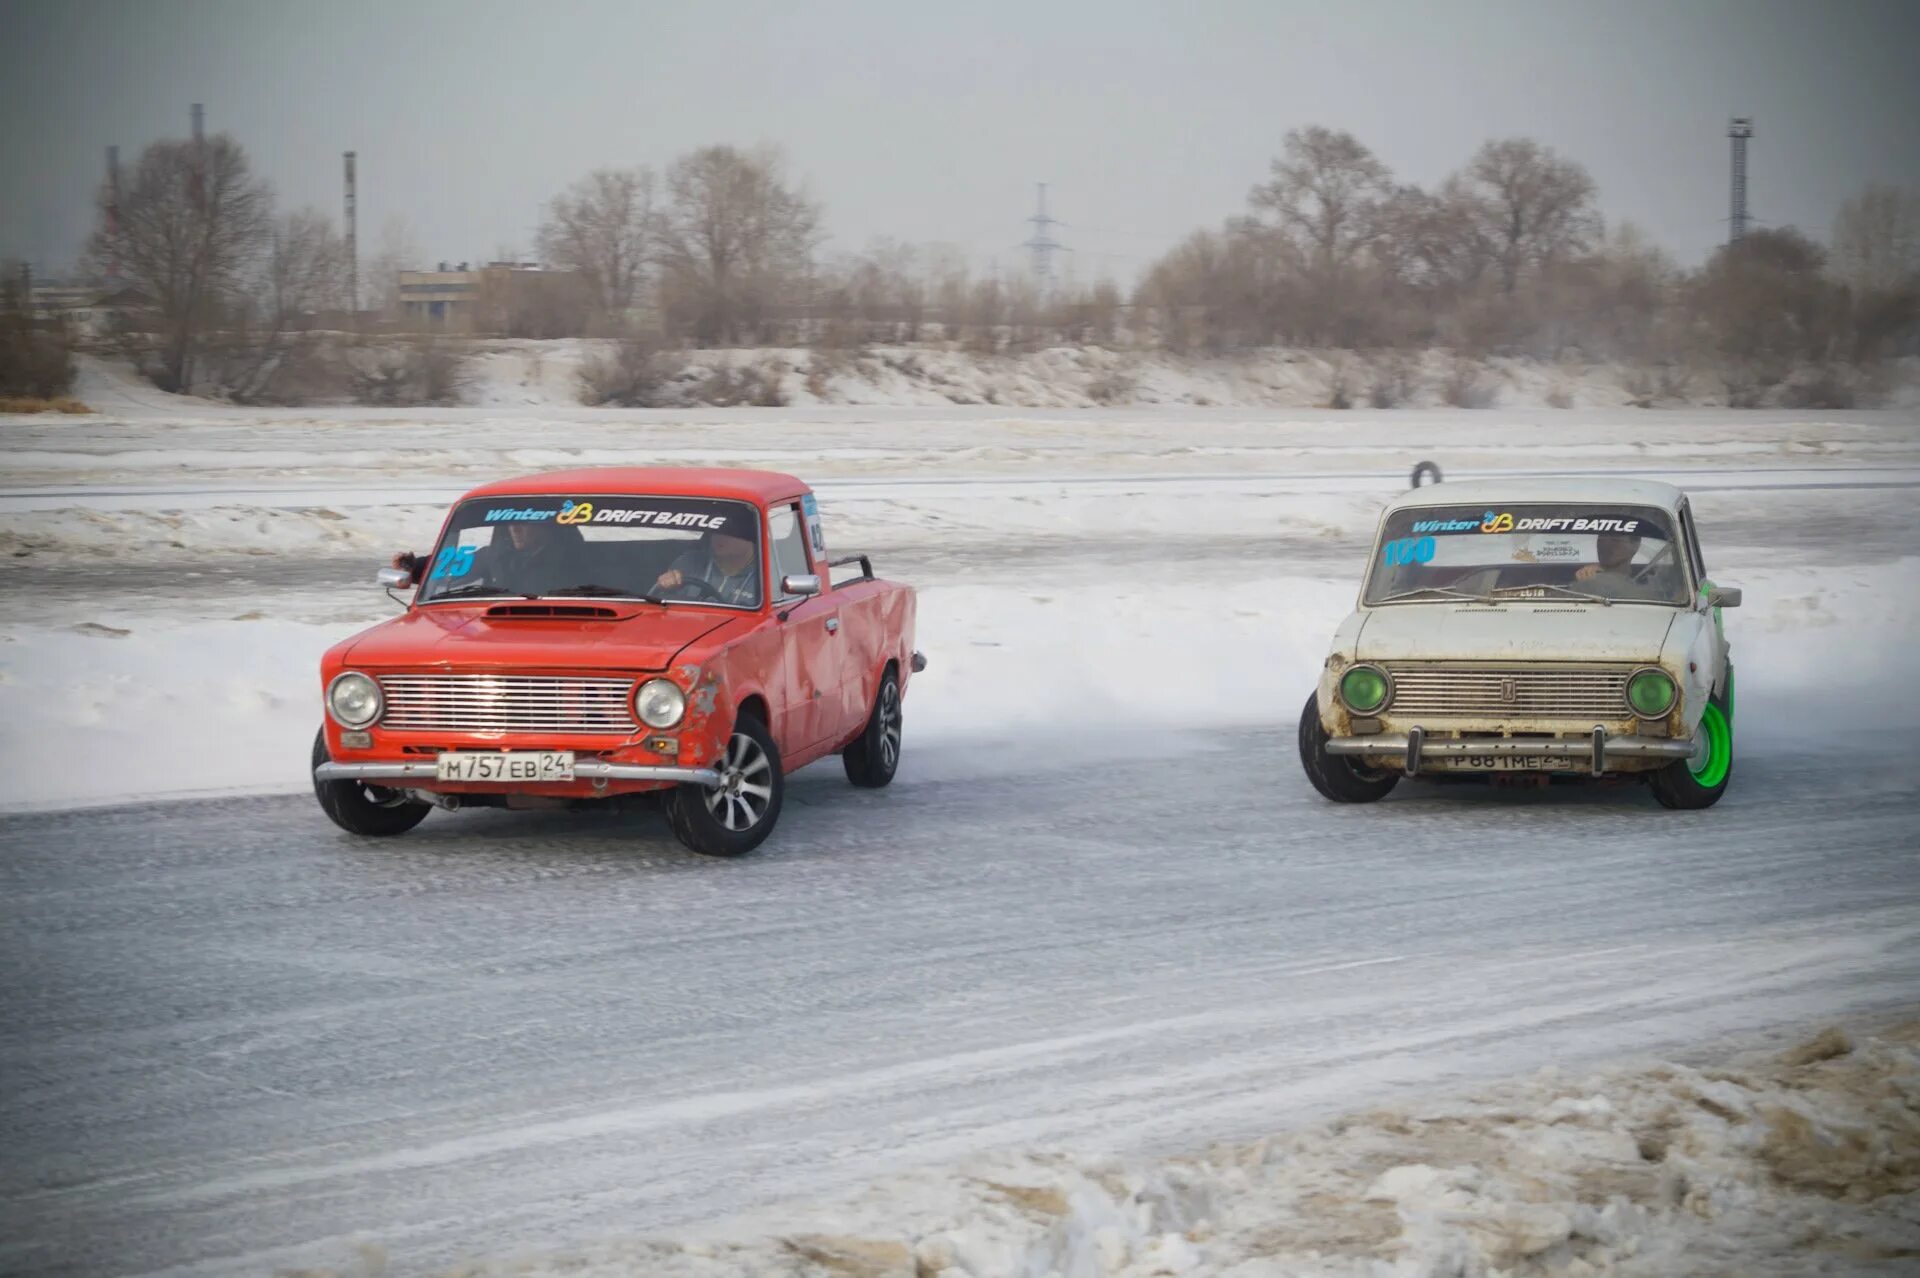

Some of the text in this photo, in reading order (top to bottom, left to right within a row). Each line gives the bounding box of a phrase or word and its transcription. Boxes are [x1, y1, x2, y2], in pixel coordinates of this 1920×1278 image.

[485, 508, 557, 522] Winter
[593, 509, 657, 524] DRIFT
[653, 511, 727, 529] BATTLE
[1412, 519, 1480, 533] Winter
[1516, 518, 1576, 531] DRIFT
[1572, 519, 1639, 533] BATTLE
[1384, 536, 1437, 567] 100
[431, 545, 477, 580] 25
[543, 754, 565, 772] 24
